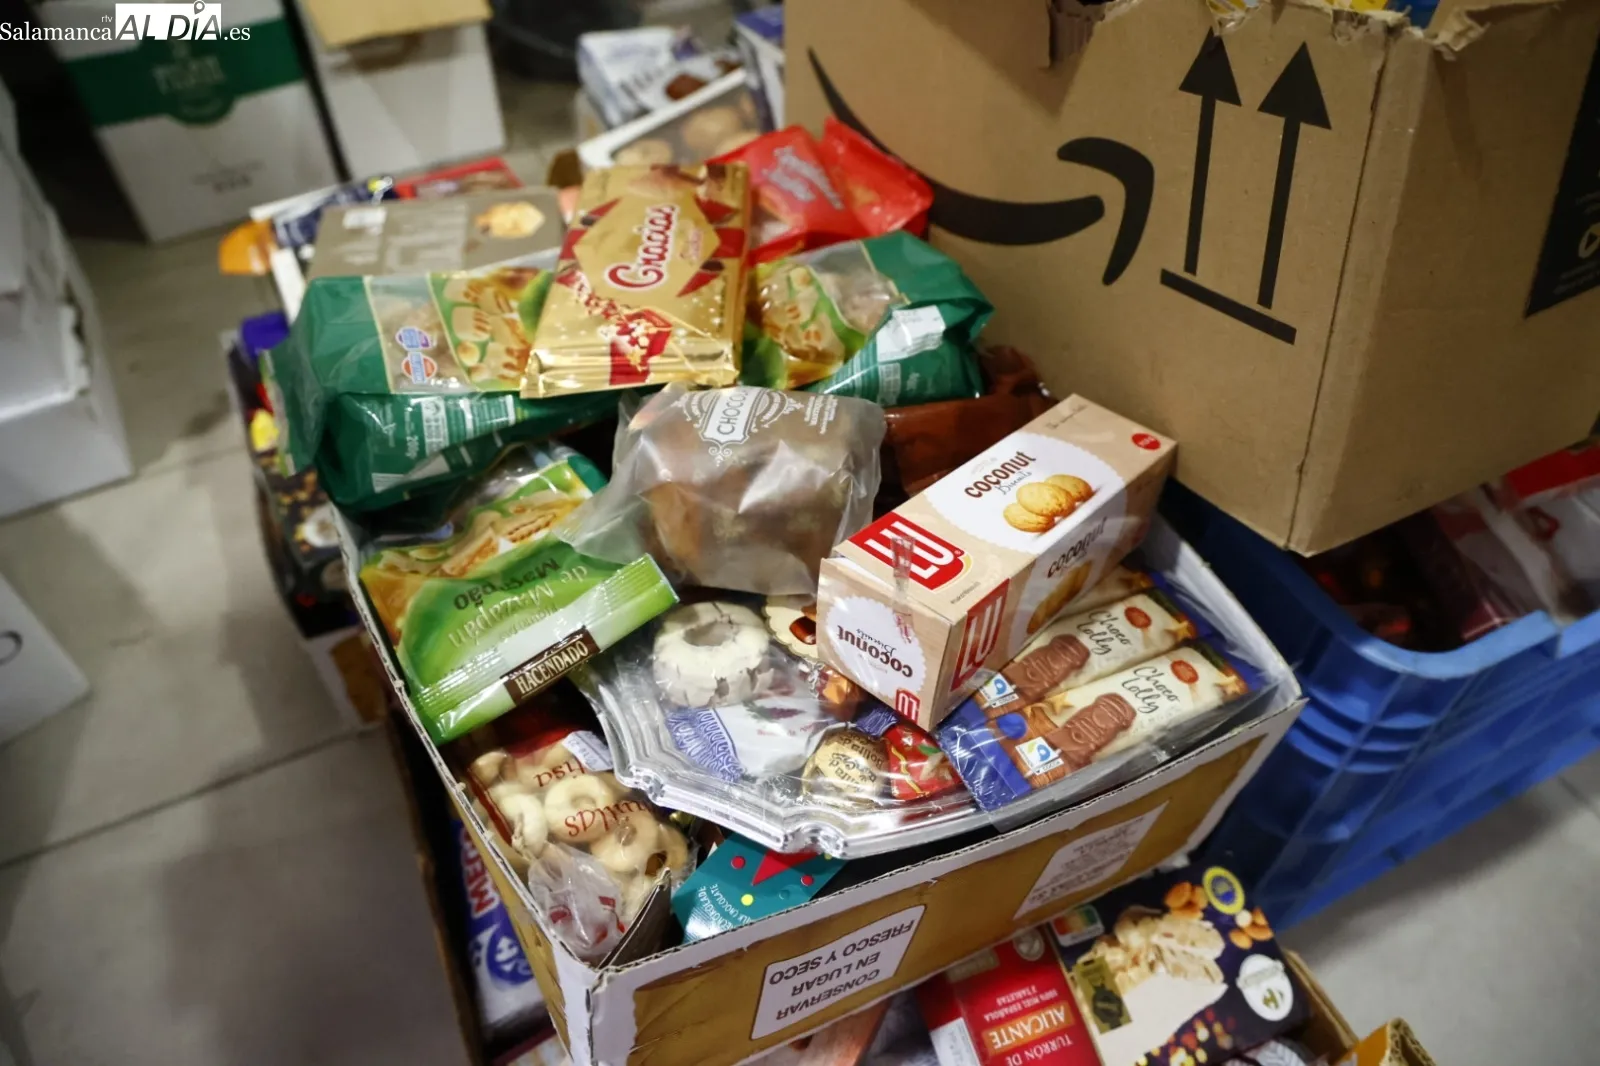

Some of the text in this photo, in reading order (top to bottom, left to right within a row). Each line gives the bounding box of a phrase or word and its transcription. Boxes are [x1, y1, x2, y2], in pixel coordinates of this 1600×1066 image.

[963, 450, 1037, 500] coconut
[863, 519, 958, 580] LU
[1046, 516, 1110, 579] coconut
[560, 565, 588, 584] de
[836, 623, 914, 679] coconut
[959, 593, 1003, 680] LU
[1088, 609, 1134, 648] Choco
[514, 639, 590, 694] HACENDADO
[1133, 665, 1181, 705] Choco
[564, 800, 655, 837] uillas
[709, 883, 739, 918] CHOCOLATE
[769, 919, 915, 985] FRESCO Y SECO
[791, 950, 881, 997] EN LUGAR
[775, 968, 881, 1021] CONSERVAR
[988, 1005, 1065, 1050] ALICANTE
[1005, 1033, 1073, 1066] TURRÓN DE
